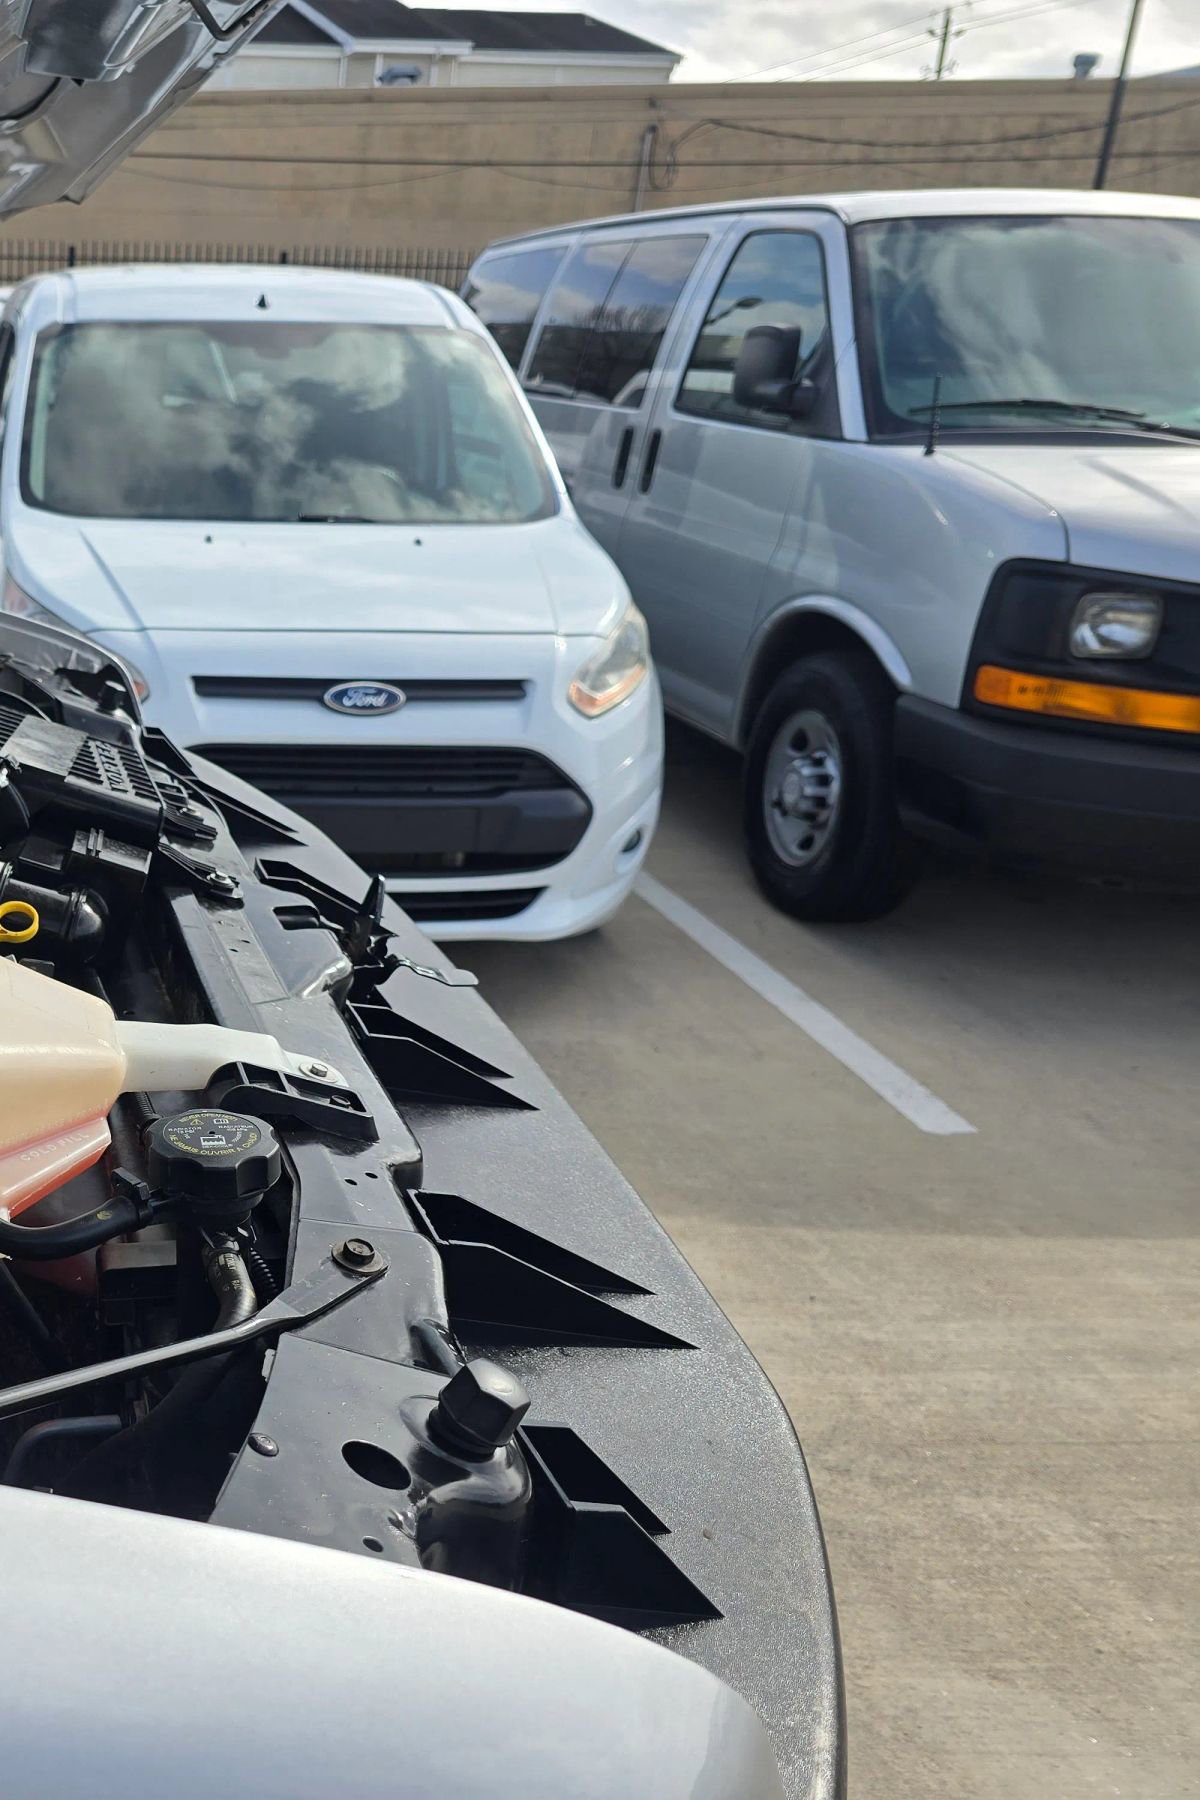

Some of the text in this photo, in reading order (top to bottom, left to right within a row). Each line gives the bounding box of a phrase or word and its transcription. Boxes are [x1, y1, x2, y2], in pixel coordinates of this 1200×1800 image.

[342, 688, 388, 707] Ford
[97, 740, 128, 793] VORTEC
[20, 1133, 90, 1161] COLD FILL
